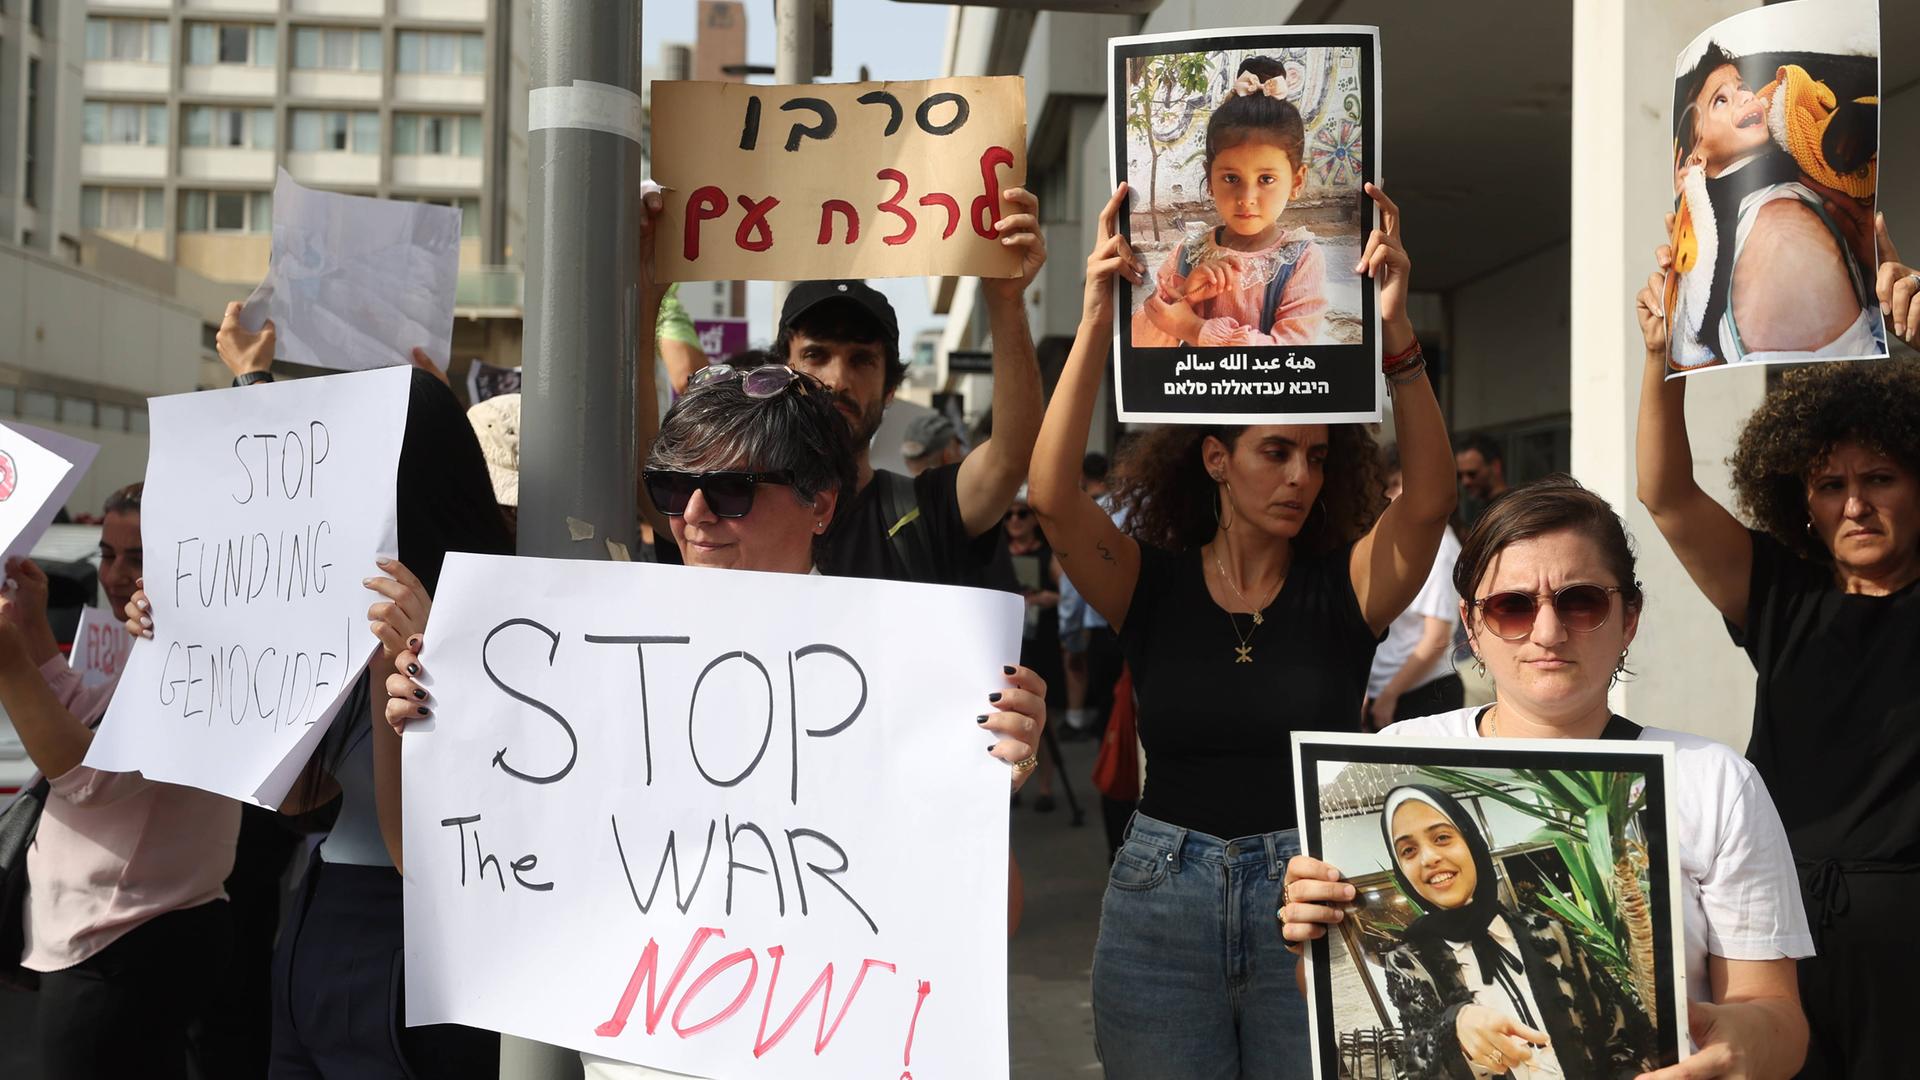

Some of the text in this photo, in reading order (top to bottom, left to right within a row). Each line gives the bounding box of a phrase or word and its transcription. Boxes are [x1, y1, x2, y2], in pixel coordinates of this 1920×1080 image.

[738, 90, 970, 152] סרבו
[683, 145, 1015, 262] לרצח עם
[1163, 379, 1330, 396] היבא עבדאללה סלאם
[1175, 352, 1316, 377] هبة عبد الله سالم
[232, 420, 331, 504] STOP
[175, 520, 333, 608] FUNDING
[159, 616, 351, 733] GENOCIDE!
[482, 617, 869, 805] STOP
[441, 812, 879, 935] The WAR
